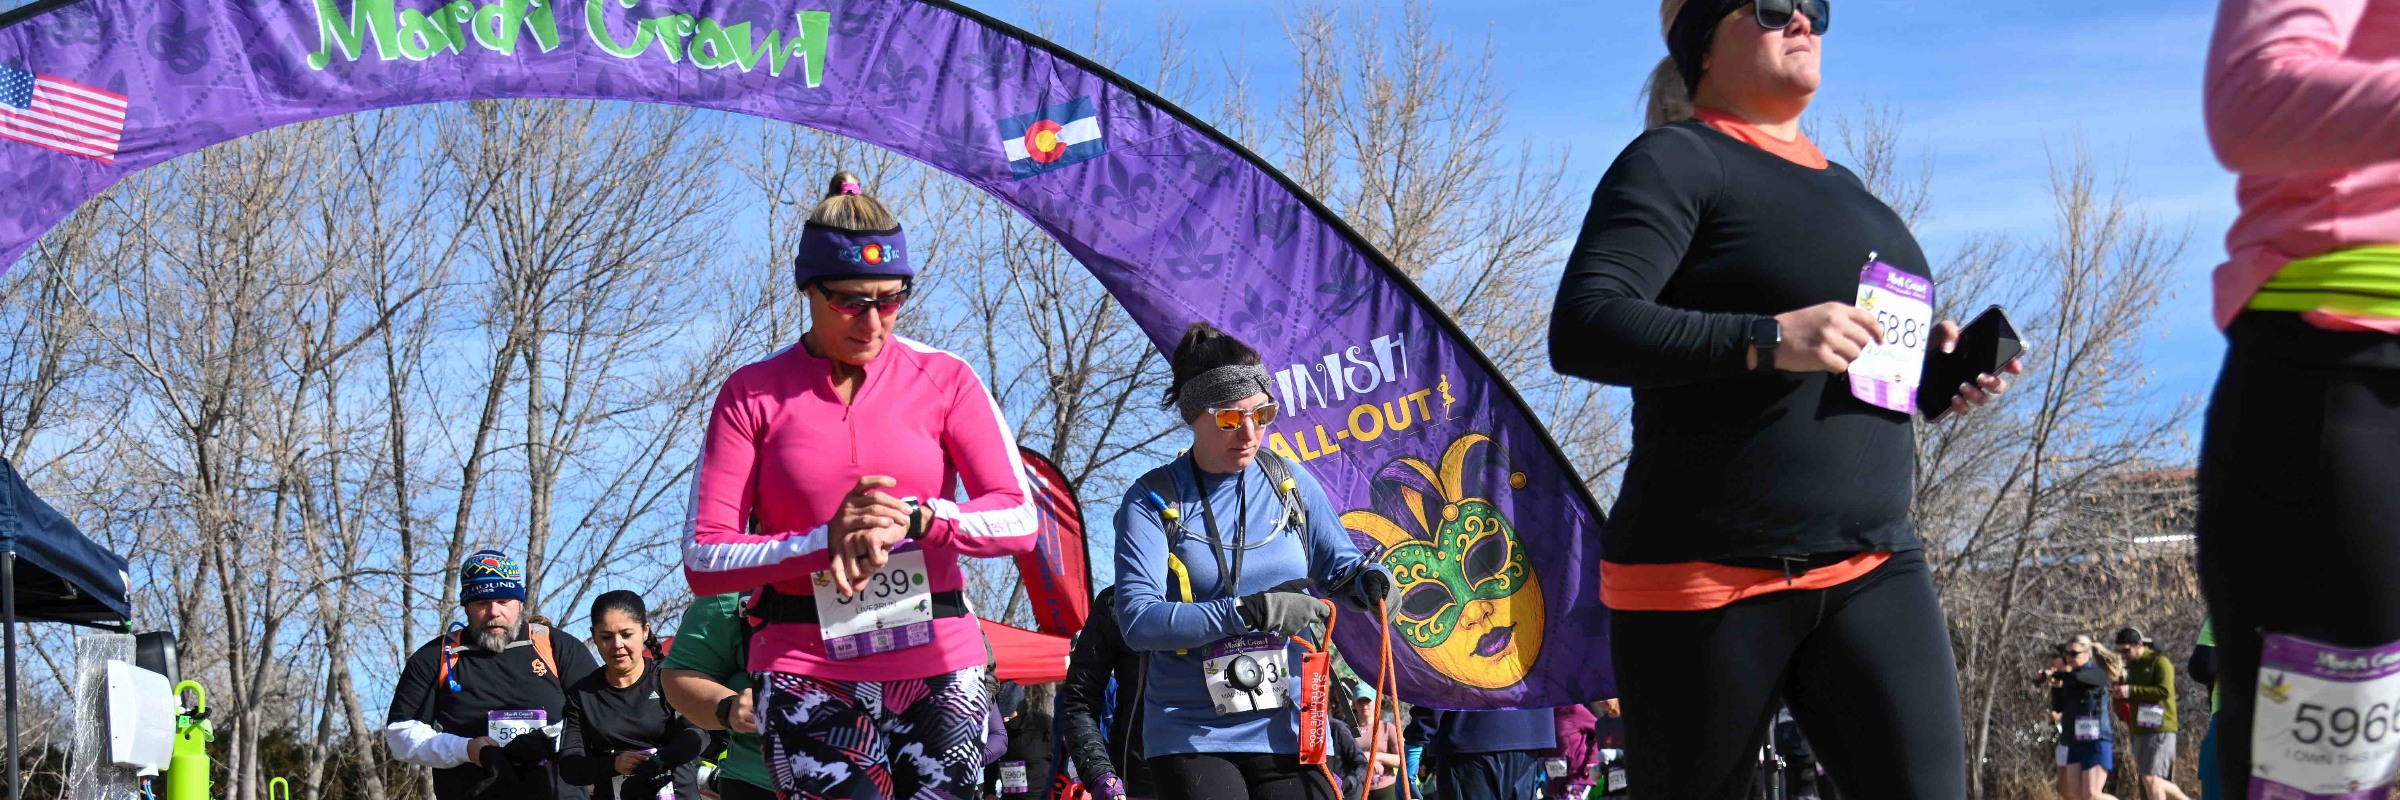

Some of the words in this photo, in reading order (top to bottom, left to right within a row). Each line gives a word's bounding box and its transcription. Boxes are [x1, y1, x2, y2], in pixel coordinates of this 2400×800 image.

[307, 0, 560, 71] Mardi
[585, 0, 830, 88] Crawl
[1272, 332, 1408, 417] INISH
[1268, 388, 1432, 464] ALL-OUT
[855, 600, 897, 615] LIVE2RUN
[1310, 672, 1319, 726] PROTECTIVE
[1317, 674, 1327, 707] STAY
[499, 727, 536, 741] 58
[1309, 728, 1317, 748] DOG
[1315, 710, 1325, 745] BACK
